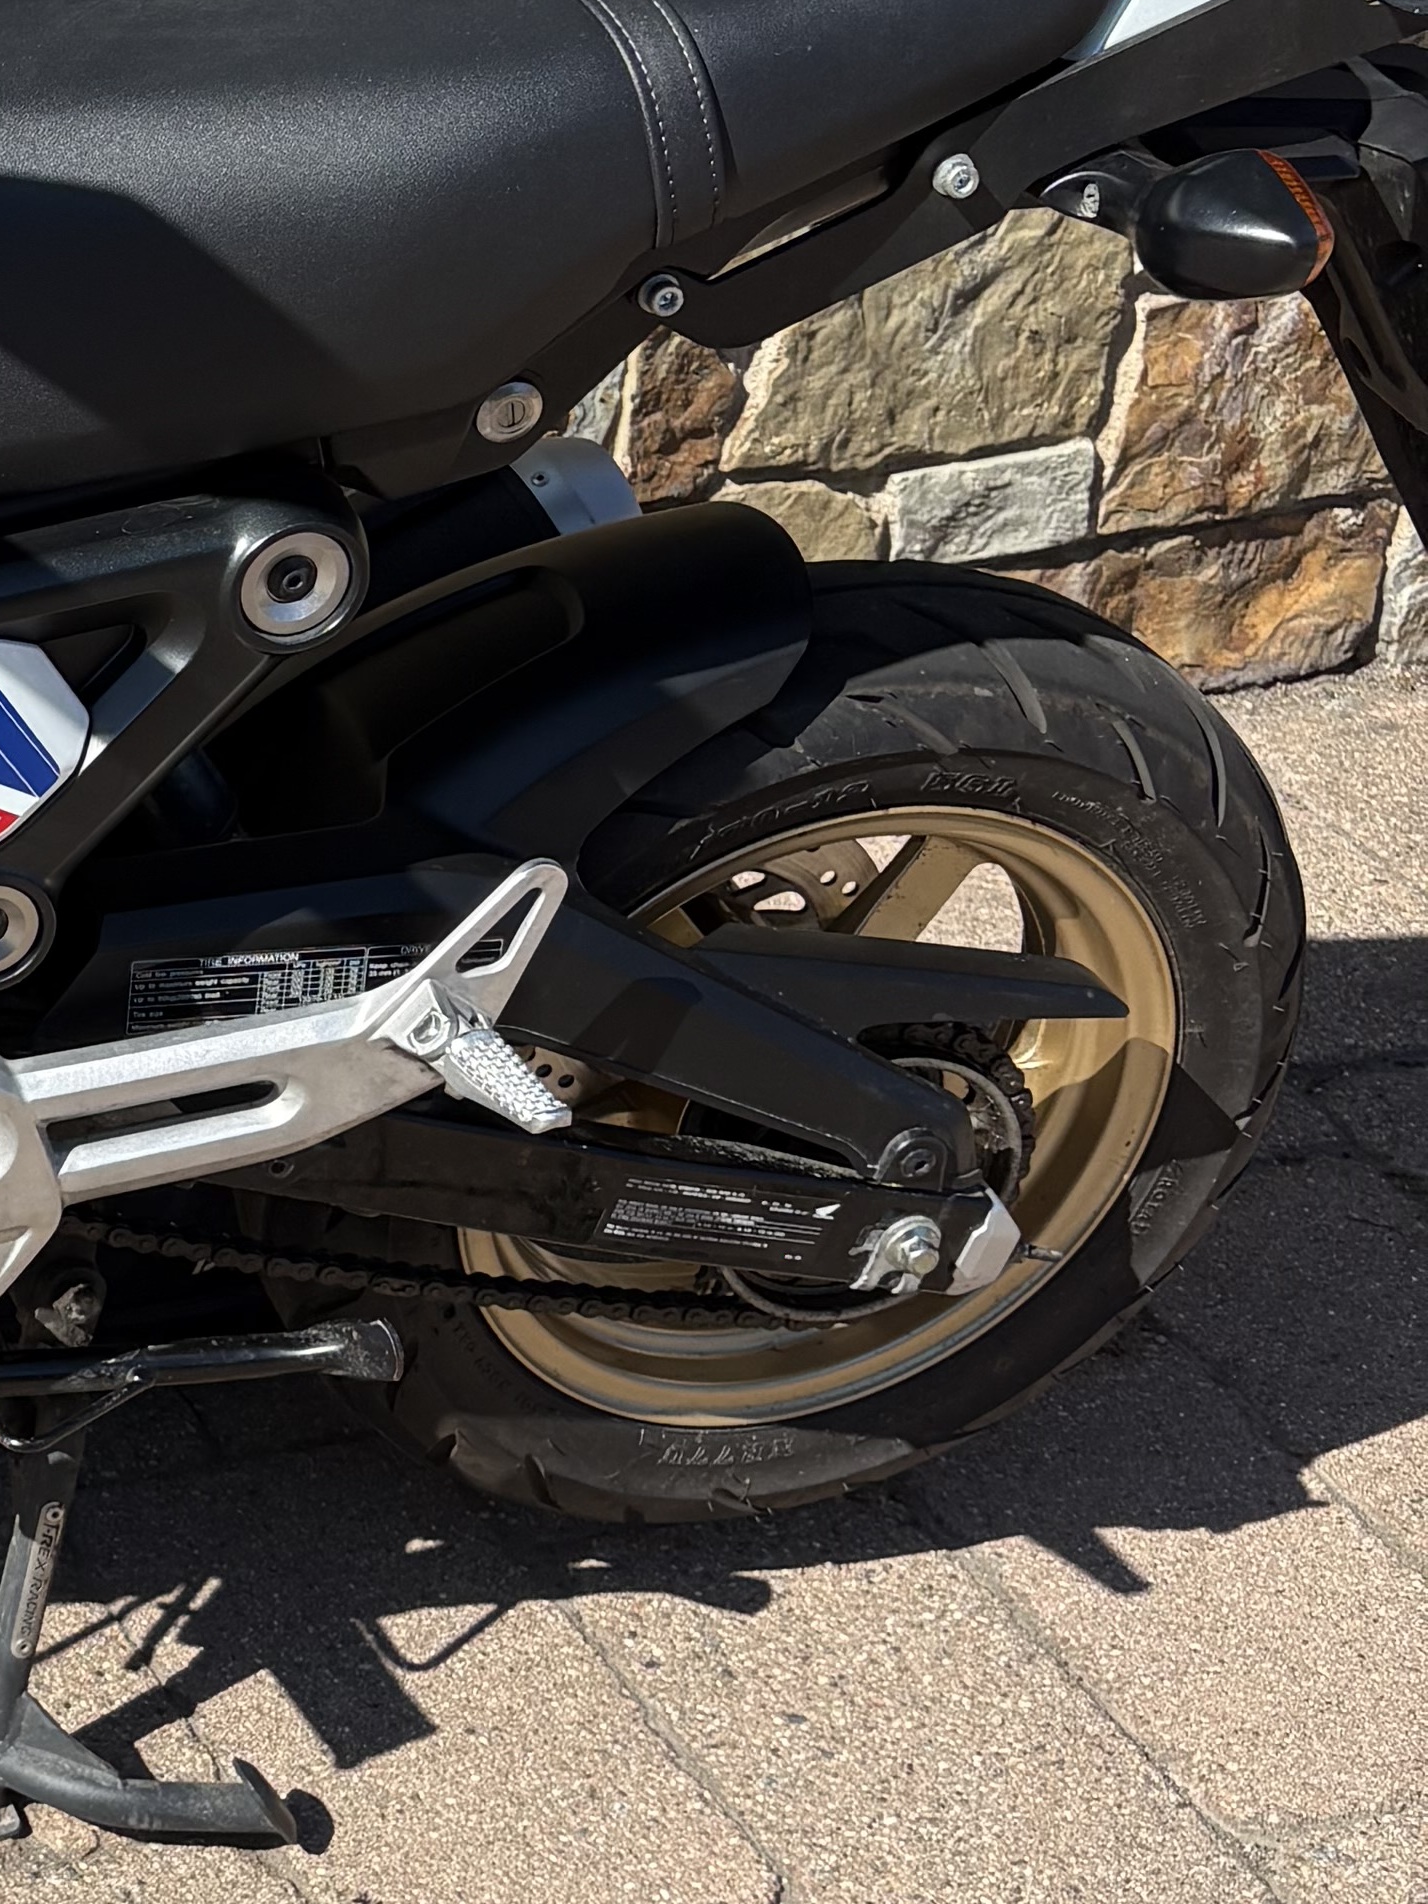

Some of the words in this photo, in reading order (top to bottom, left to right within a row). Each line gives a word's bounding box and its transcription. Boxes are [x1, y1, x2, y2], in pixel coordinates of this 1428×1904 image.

[227, 951, 300, 966] INFORMATION
[34, 1522, 59, 1571] T-REX
[20, 1577, 43, 1637] RACING
